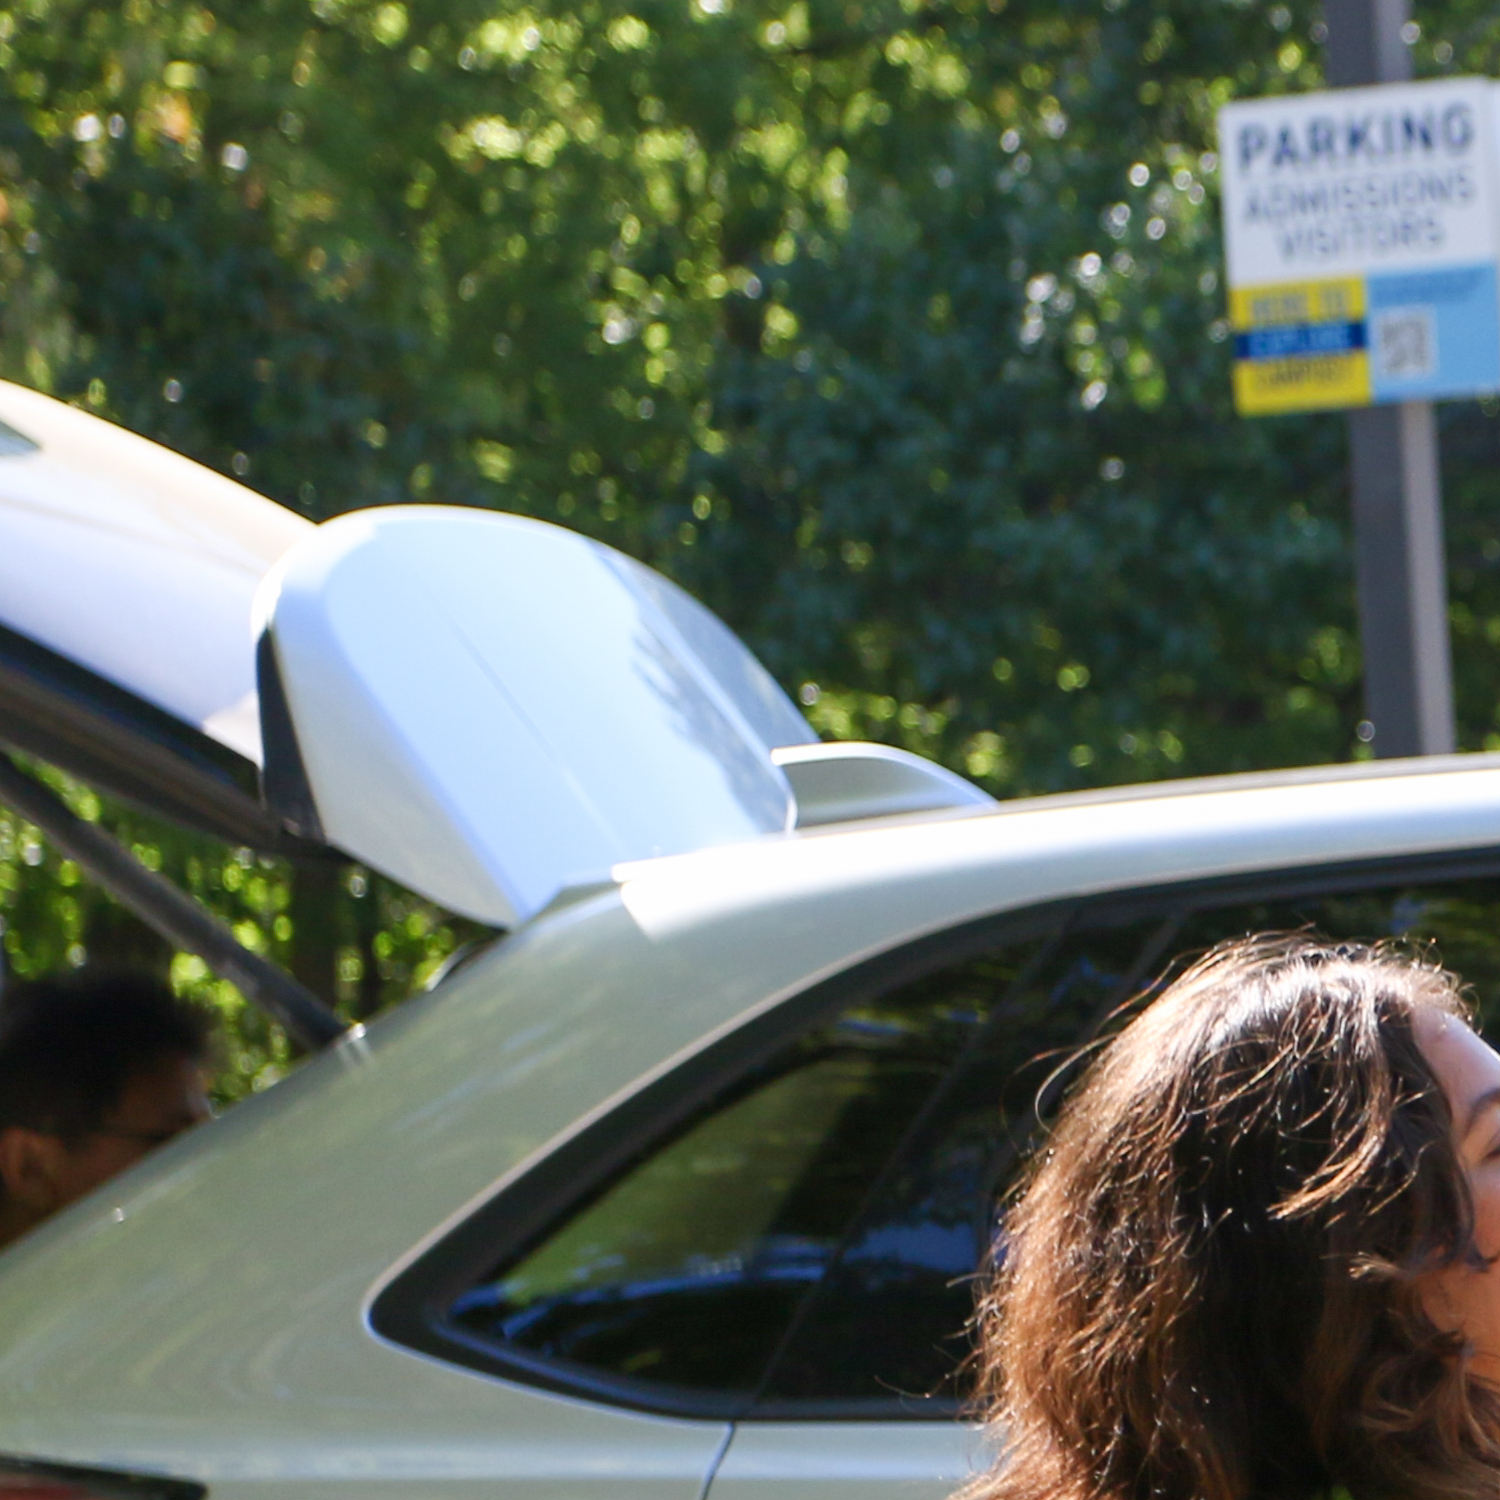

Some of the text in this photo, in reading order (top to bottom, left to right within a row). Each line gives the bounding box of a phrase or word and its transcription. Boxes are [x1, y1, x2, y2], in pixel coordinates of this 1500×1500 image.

[1238, 104, 1475, 170] PARKING
[1246, 169, 1475, 220] ADMISSIONS
[1280, 214, 1444, 258] VISITORS
